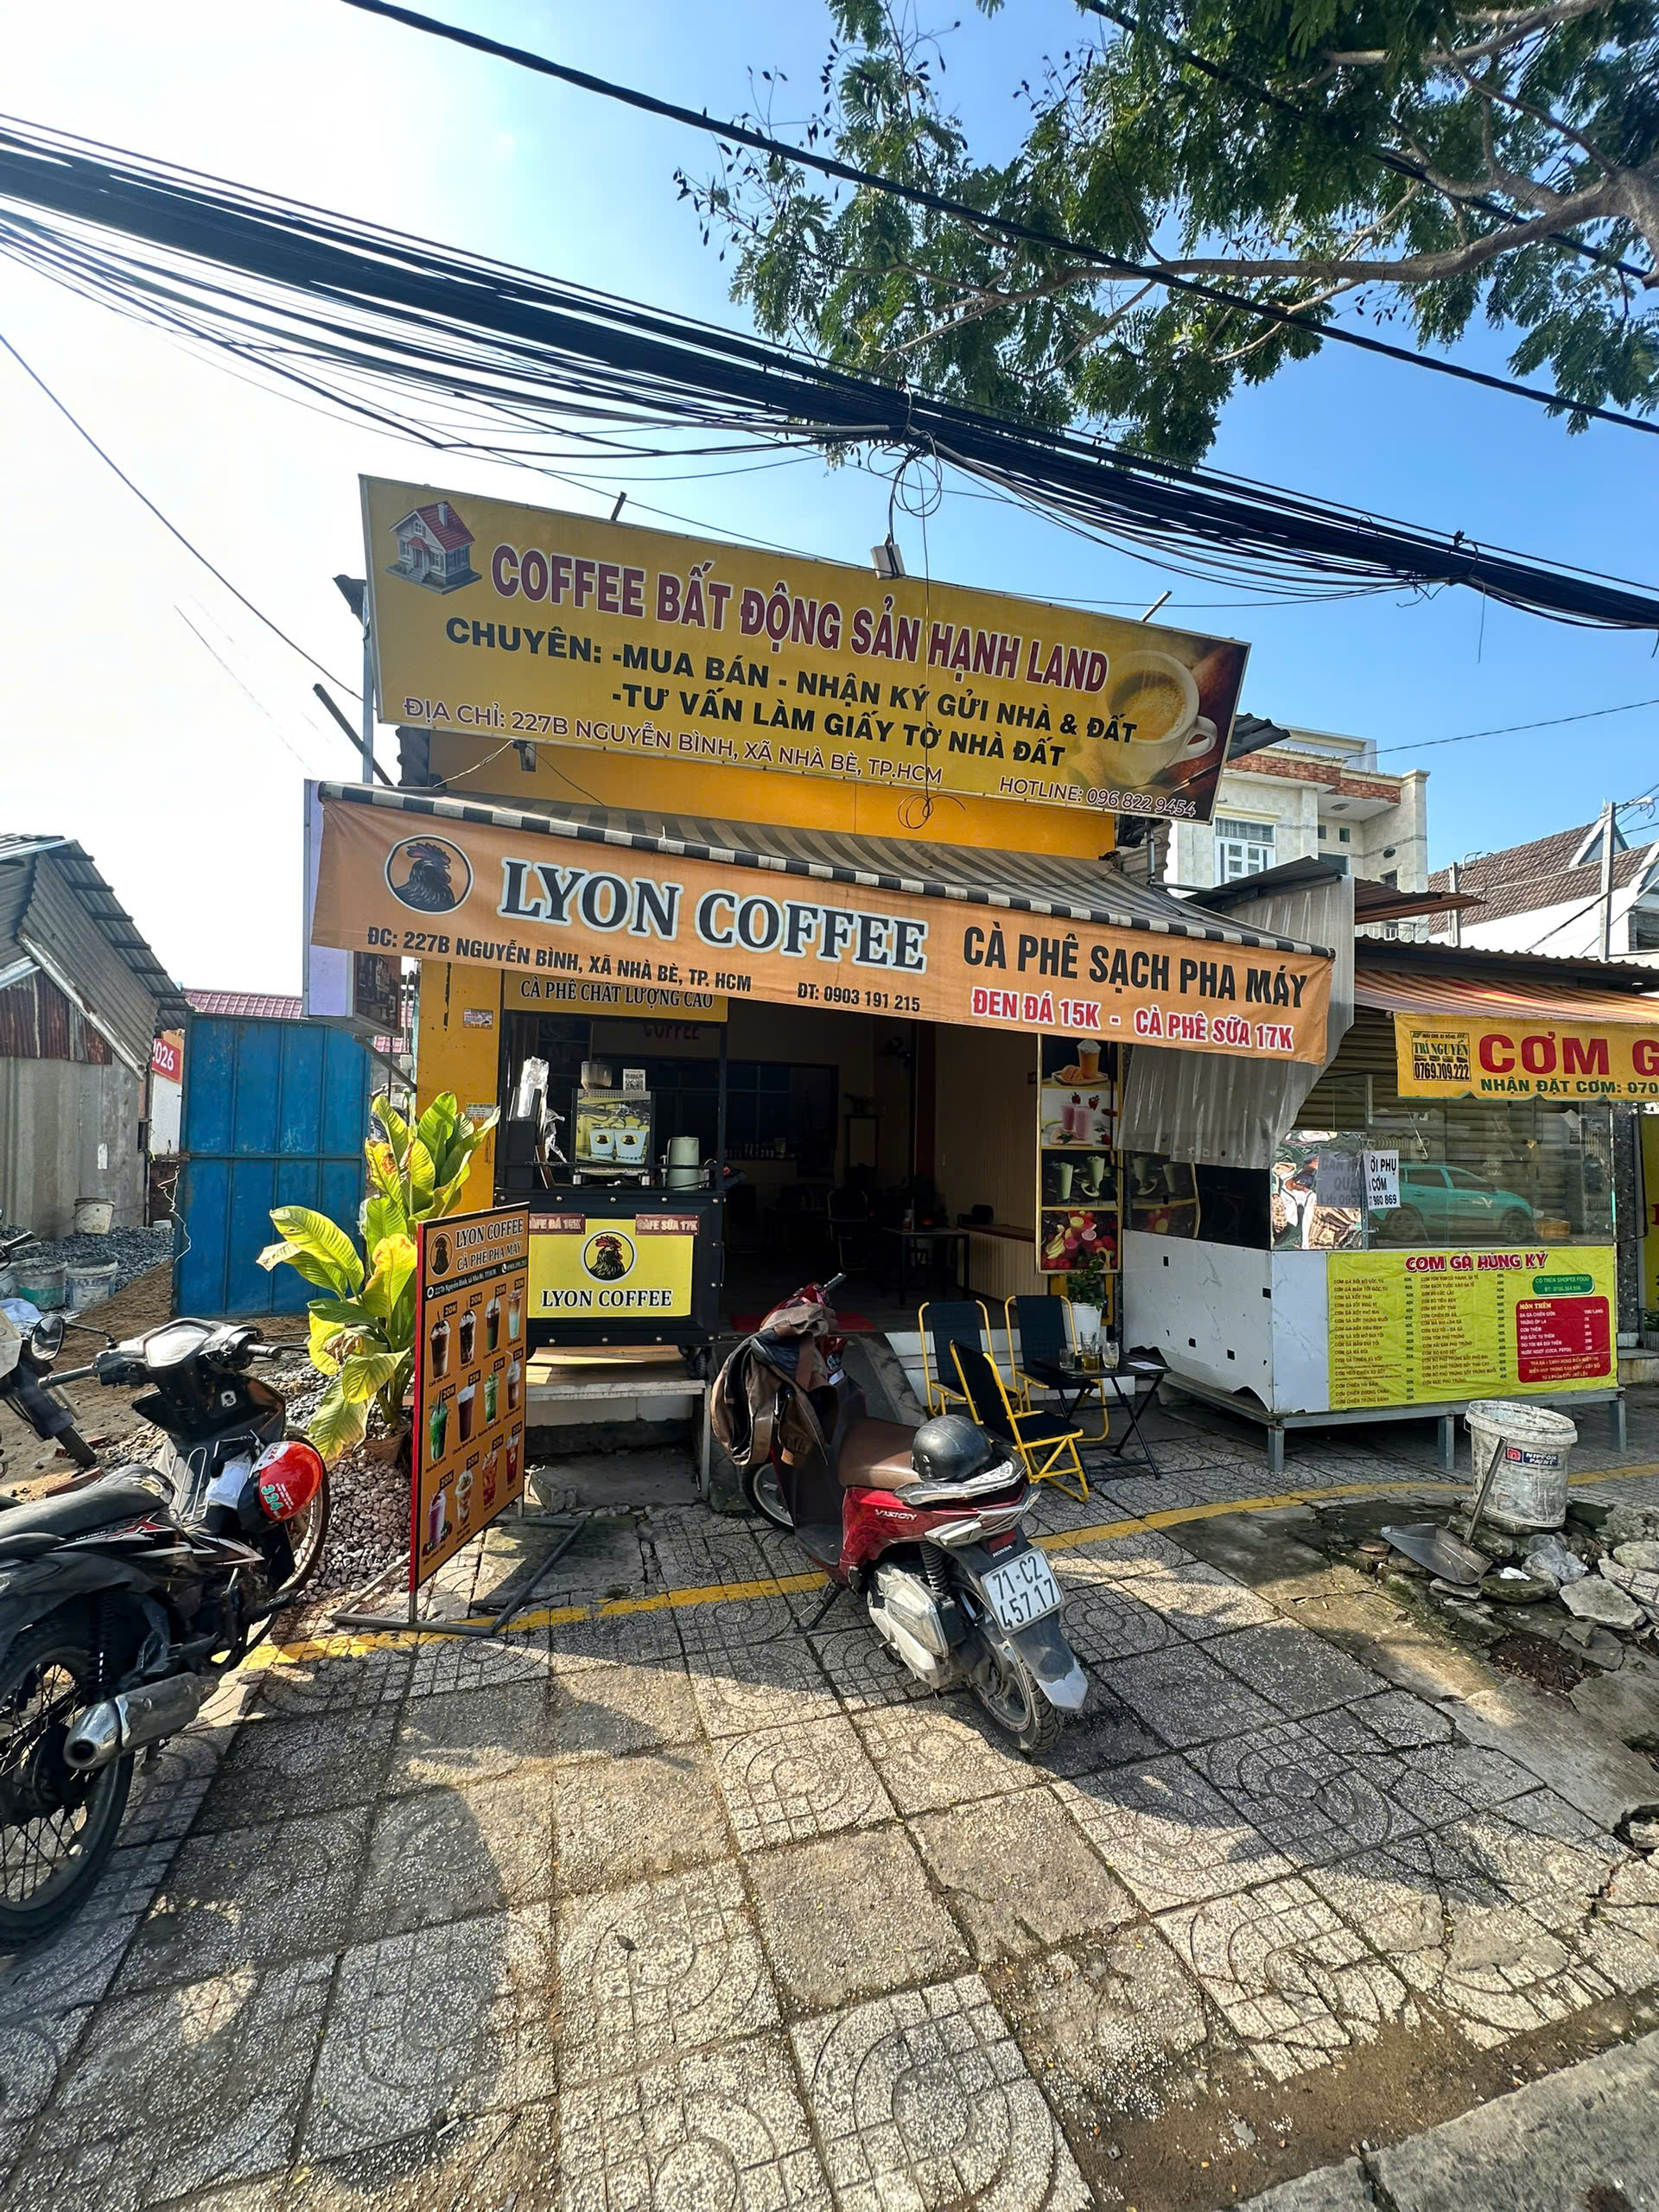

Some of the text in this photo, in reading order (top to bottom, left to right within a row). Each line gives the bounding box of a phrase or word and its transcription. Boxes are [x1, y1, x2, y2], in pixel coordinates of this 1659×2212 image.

[492, 544, 1109, 693] COFFEE BẤT ĐỘNG SẢN HẠNH LAND
[446, 617, 601, 664] CHUYÊN:
[612, 644, 694, 678] -MUA
[704, 655, 768, 689] BÁN
[797, 671, 878, 705] NHẬN
[890, 680, 929, 711] KÝ
[938, 690, 988, 721] GỬI
[996, 697, 1051, 732] NHÀ
[1059, 715, 1077, 735] &
[1086, 713, 1137, 744] ĐẤT
[680, 688, 742, 722] VẤN
[753, 701, 814, 733] LÀM
[823, 709, 893, 743] GIẤY
[903, 723, 940, 749] TỜ
[949, 729, 1003, 758] NHÀ
[1013, 737, 1065, 766] ĐẤT
[404, 696, 1197, 818] ĐỊA CHỈ: 227B NGUYỄN BÌNH, XÃ NHÀ BÈ, TP.HCM HOTLINE: 096 822 9454
[499, 858, 926, 972] LYON COFFEE
[367, 926, 920, 1012] ĐC: 227B NGUYỄN BÌNH, XÃ NHÀ BÈ, TP. HCM ĐT: 0903 191 215
[963, 921, 1307, 1007] CÀ PHÊ SẠCH PHA MÁY
[520, 976, 542, 998] CÀ
[545, 978, 577, 1001] PHÊ
[683, 993, 713, 1008] CAO
[971, 988, 1018, 1020] ĐEN
[1022, 991, 1053, 1024] ĐÁ
[1059, 999, 1100, 1029] 15K
[1134, 1004, 1163, 1037] CÀ
[1166, 1010, 1209, 1042] PHÊ
[1211, 1012, 1251, 1047] SỮA
[1255, 1021, 1294, 1051] 17K
[1478, 1031, 1610, 1075] CƠM
[1414, 1062, 1470, 1080] 0769.709.222
[1481, 1077, 1659, 1095] NHẬN ĐẶT CƠM: 070
[1380, 1158, 1397, 1175] PHỤ
[1371, 1175, 1388, 1192] CƠM
[1384, 1193, 1397, 1205] 869
[456, 1217, 524, 1249] LYON COFFEE
[563, 1218, 582, 1230] 15K
[680, 1220, 698, 1230] 17K
[456, 1253, 468, 1271] CÀ
[470, 1247, 487, 1268] PHÊ
[489, 1246, 505, 1262] PHA
[1405, 1255, 1446, 1272] CƠM
[1449, 1253, 1473, 1271] GÀ
[541, 1289, 672, 1307] LYON COFFEE
[261, 1484, 284, 1511] 324
[874, 1509, 918, 1521] VISION
[993, 1545, 1013, 1557] HONDA
[1000, 1578, 1056, 1629] 457.17
